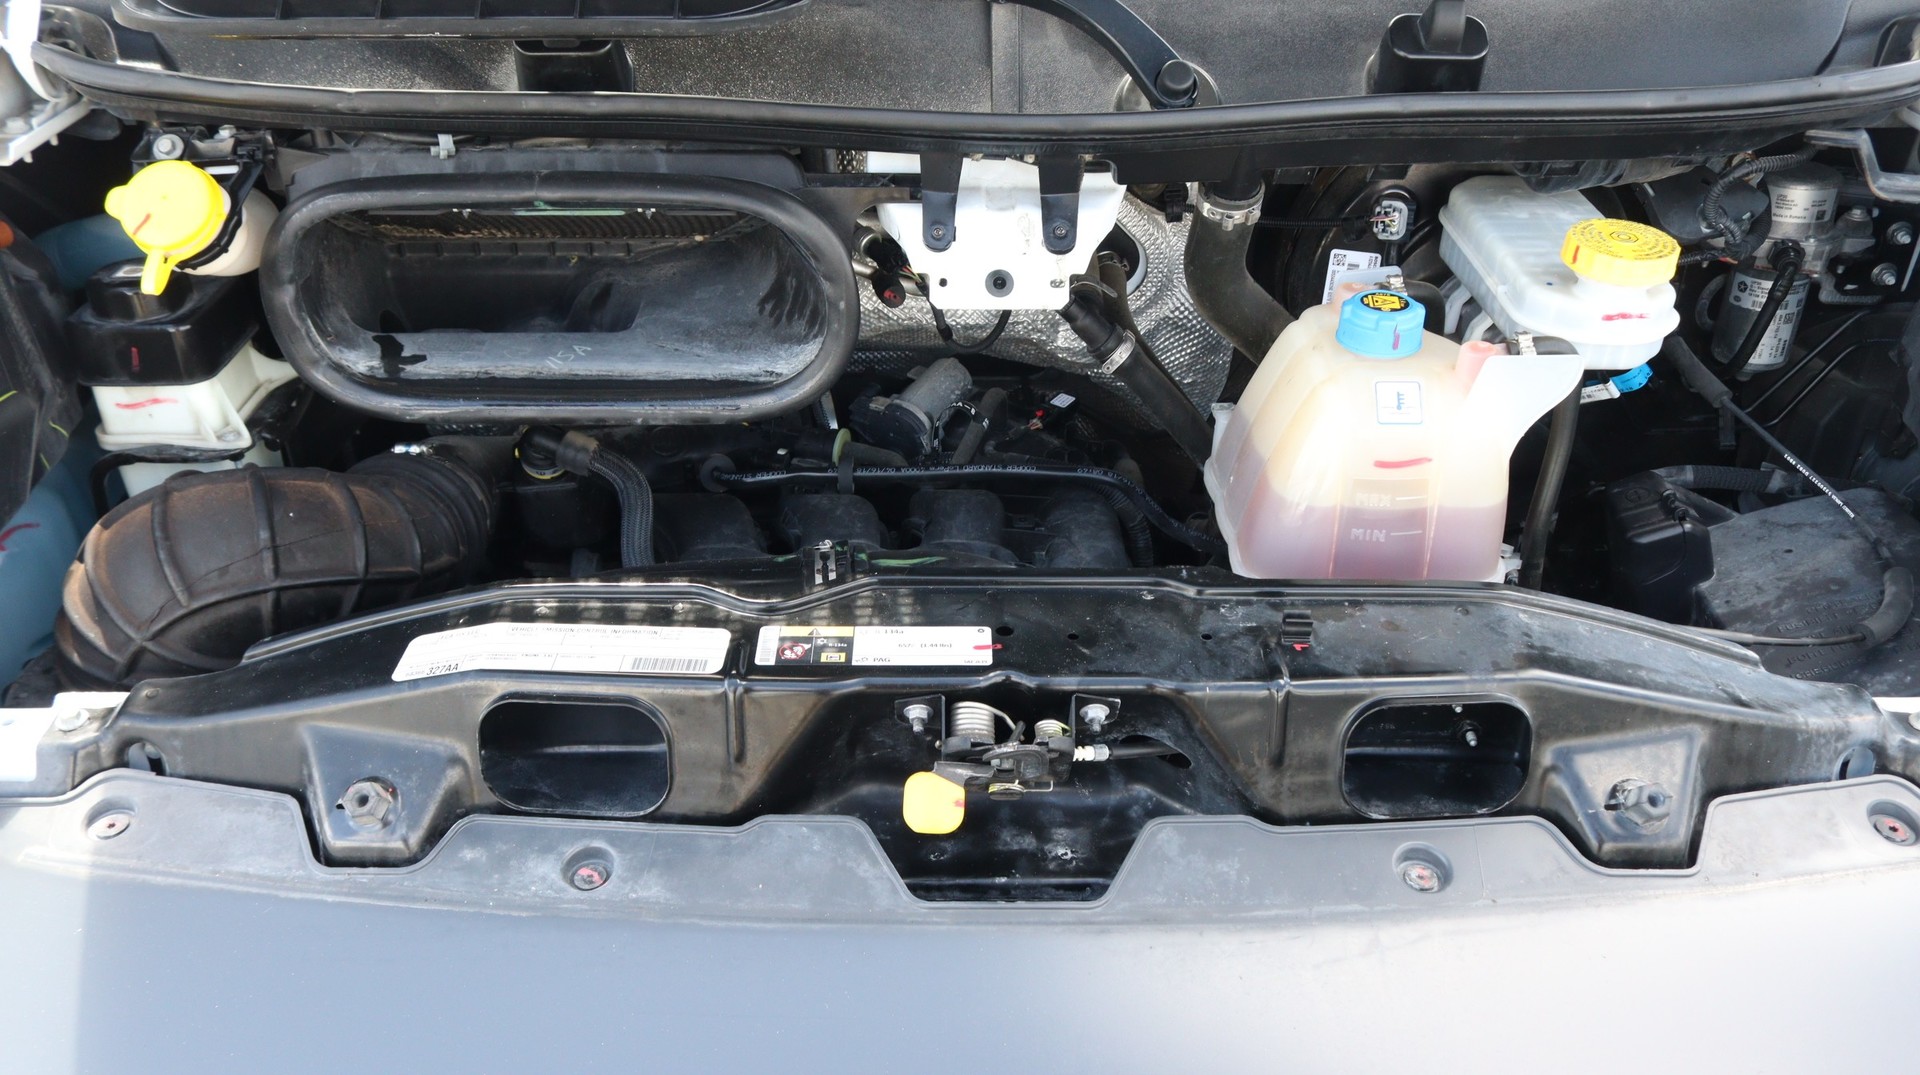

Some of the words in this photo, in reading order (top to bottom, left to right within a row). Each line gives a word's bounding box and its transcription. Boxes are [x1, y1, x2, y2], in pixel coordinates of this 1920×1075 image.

[962, 463, 1003, 472] STANDARD
[1005, 464, 1037, 472] COOPER
[1350, 528, 1387, 542] MIN
